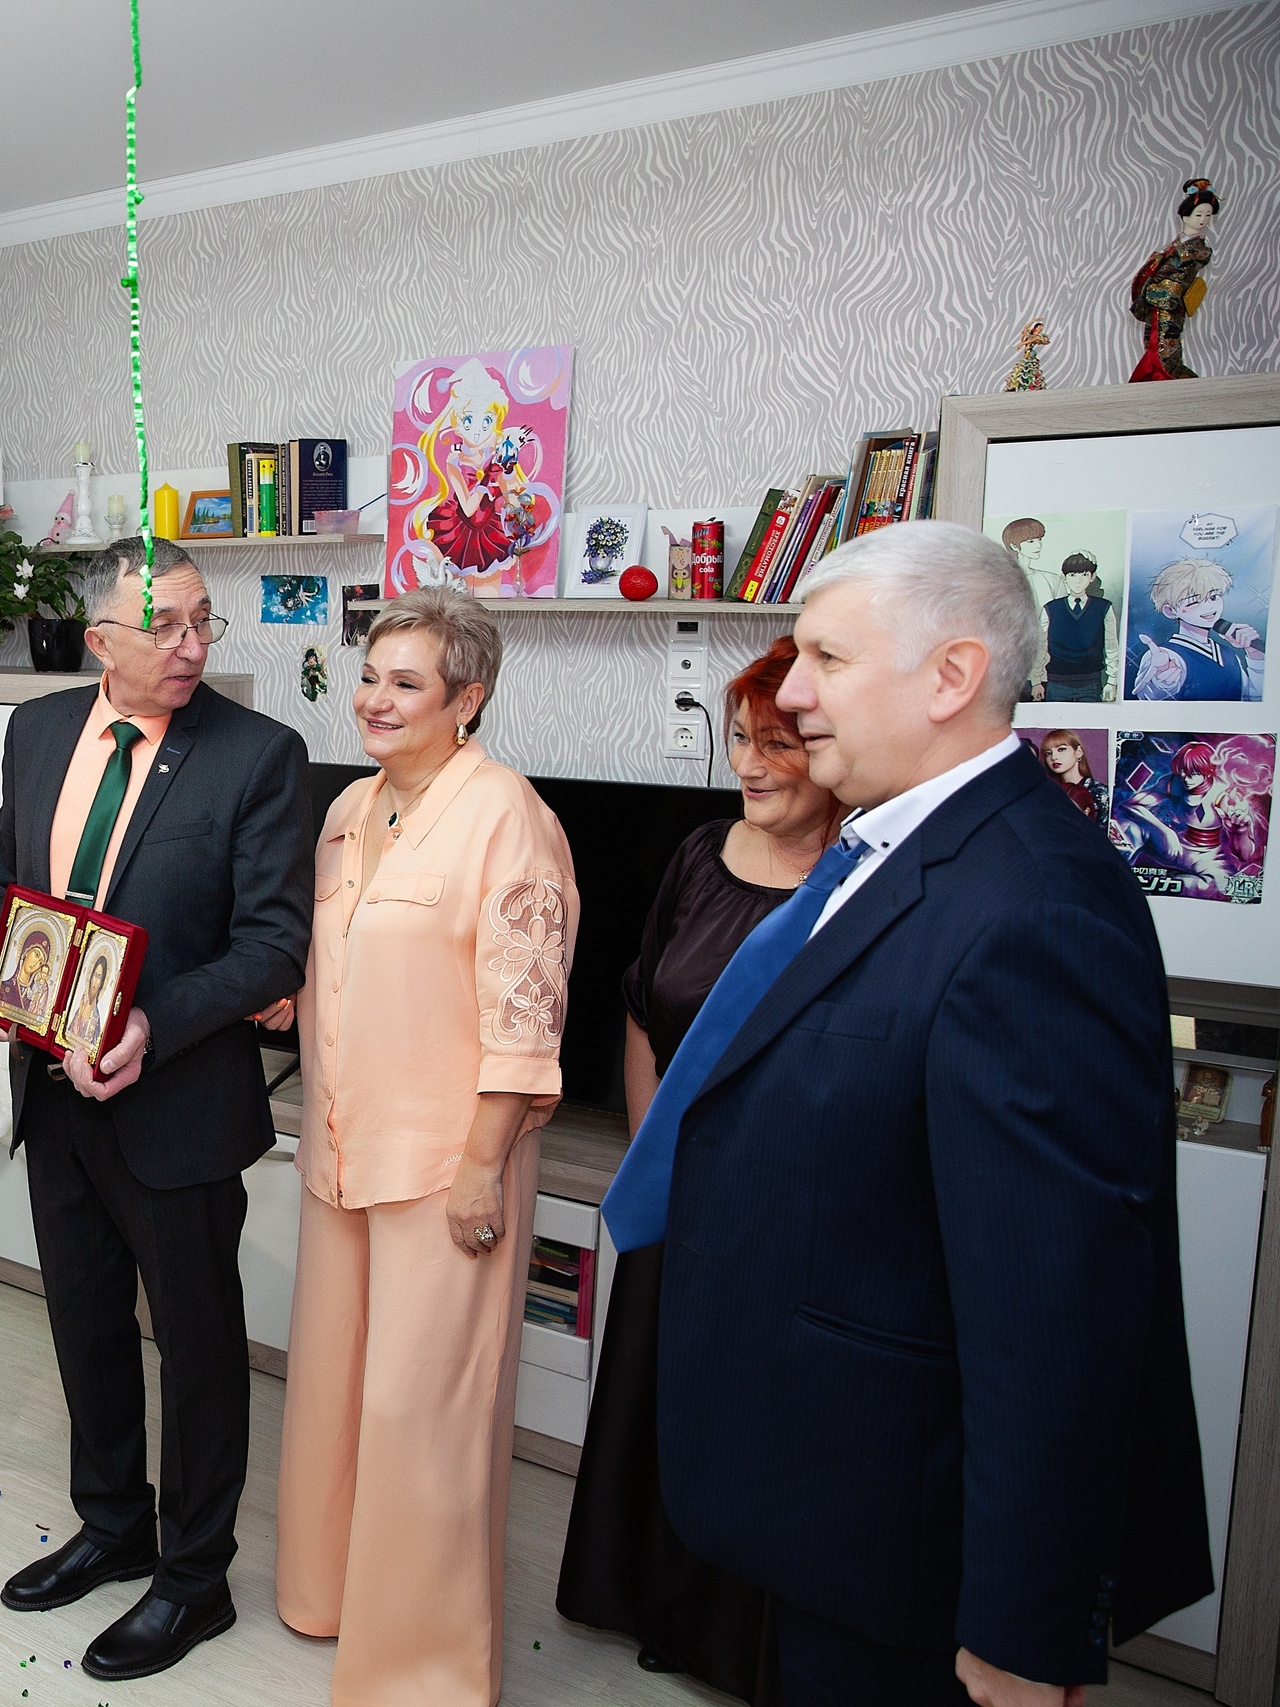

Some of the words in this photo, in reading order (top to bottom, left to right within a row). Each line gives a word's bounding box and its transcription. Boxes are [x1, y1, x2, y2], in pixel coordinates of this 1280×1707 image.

[898, 465, 911, 497] красная
[906, 441, 915, 464] книга
[757, 530, 781, 578] ХРЕСТОМАТИЯ
[1234, 880, 1255, 894] LR
